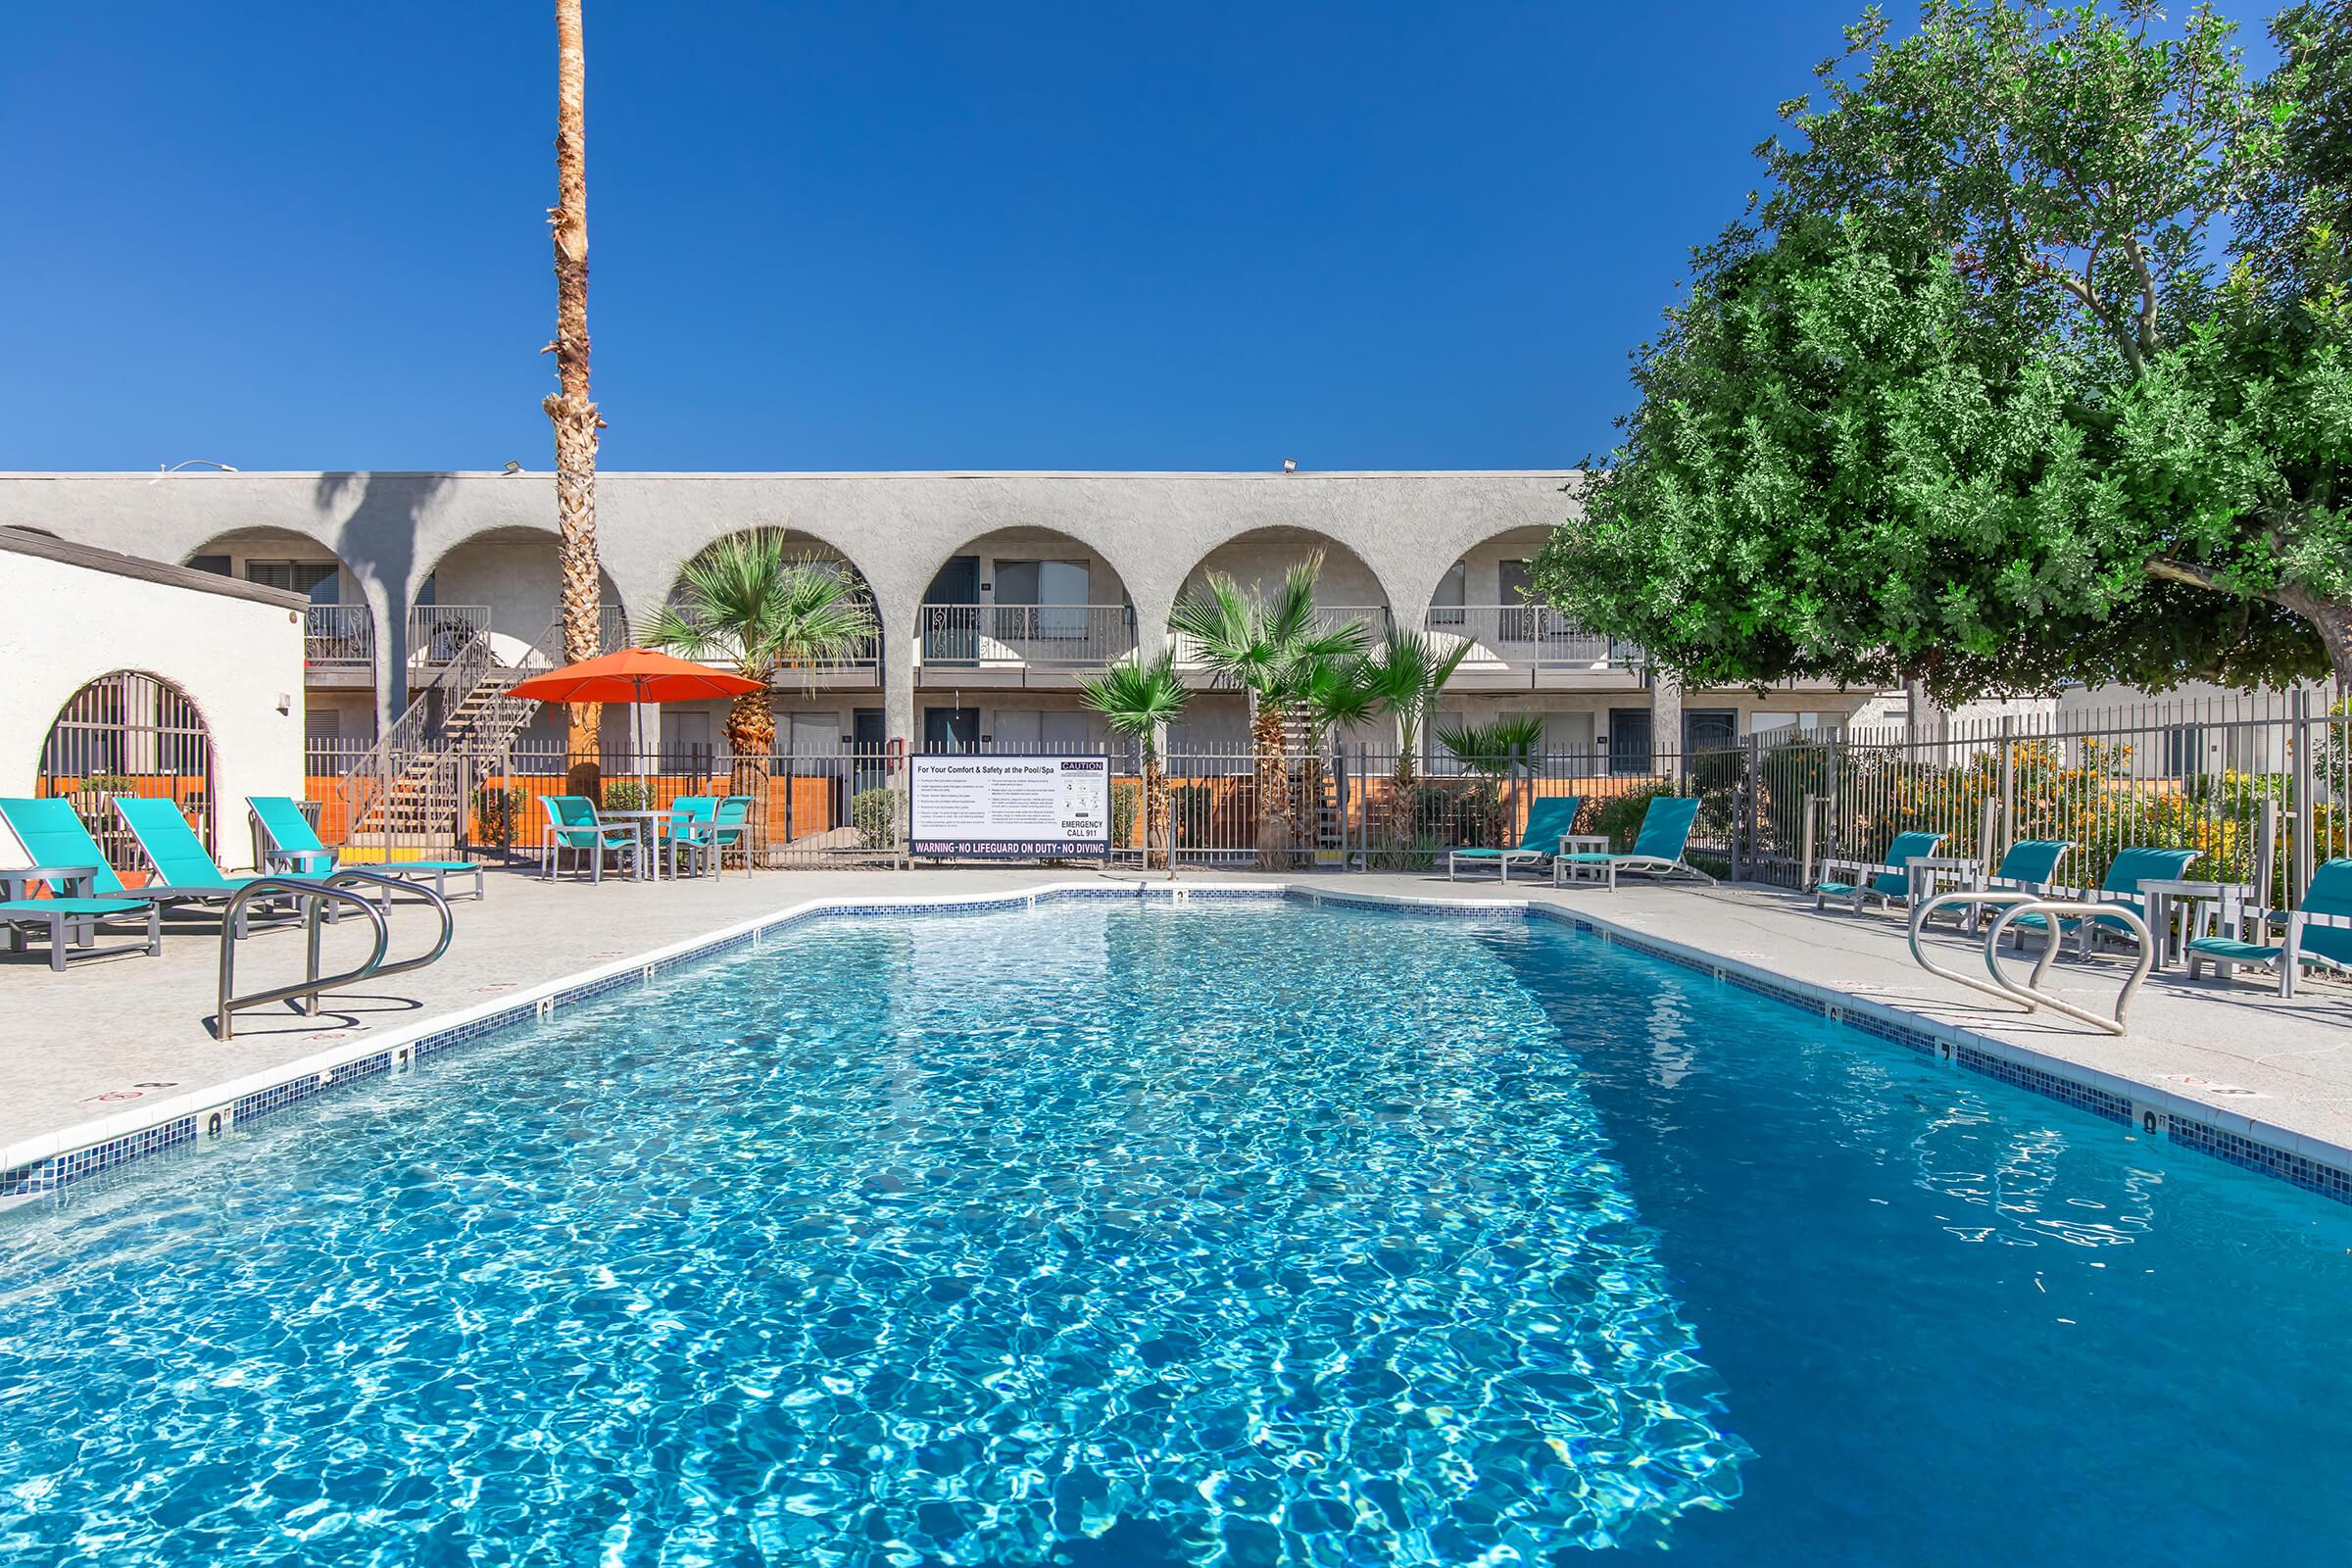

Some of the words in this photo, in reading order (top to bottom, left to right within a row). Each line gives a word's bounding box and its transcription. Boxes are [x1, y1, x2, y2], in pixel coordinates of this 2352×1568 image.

[917, 765, 929, 774] For
[931, 765, 947, 774] Your
[948, 765, 974, 774] Comfort
[975, 765, 981, 774] &
[982, 765, 1004, 776] Safety
[1012, 765, 1023, 774] the
[1024, 765, 1054, 776] Pool/Spa
[973, 843, 1019, 854] LIFEGUARD
[1021, 843, 1033, 854] ON
[1076, 843, 1104, 854] DIVING
[223, 1107, 231, 1120] FT
[2159, 1115, 2167, 1127] FT
